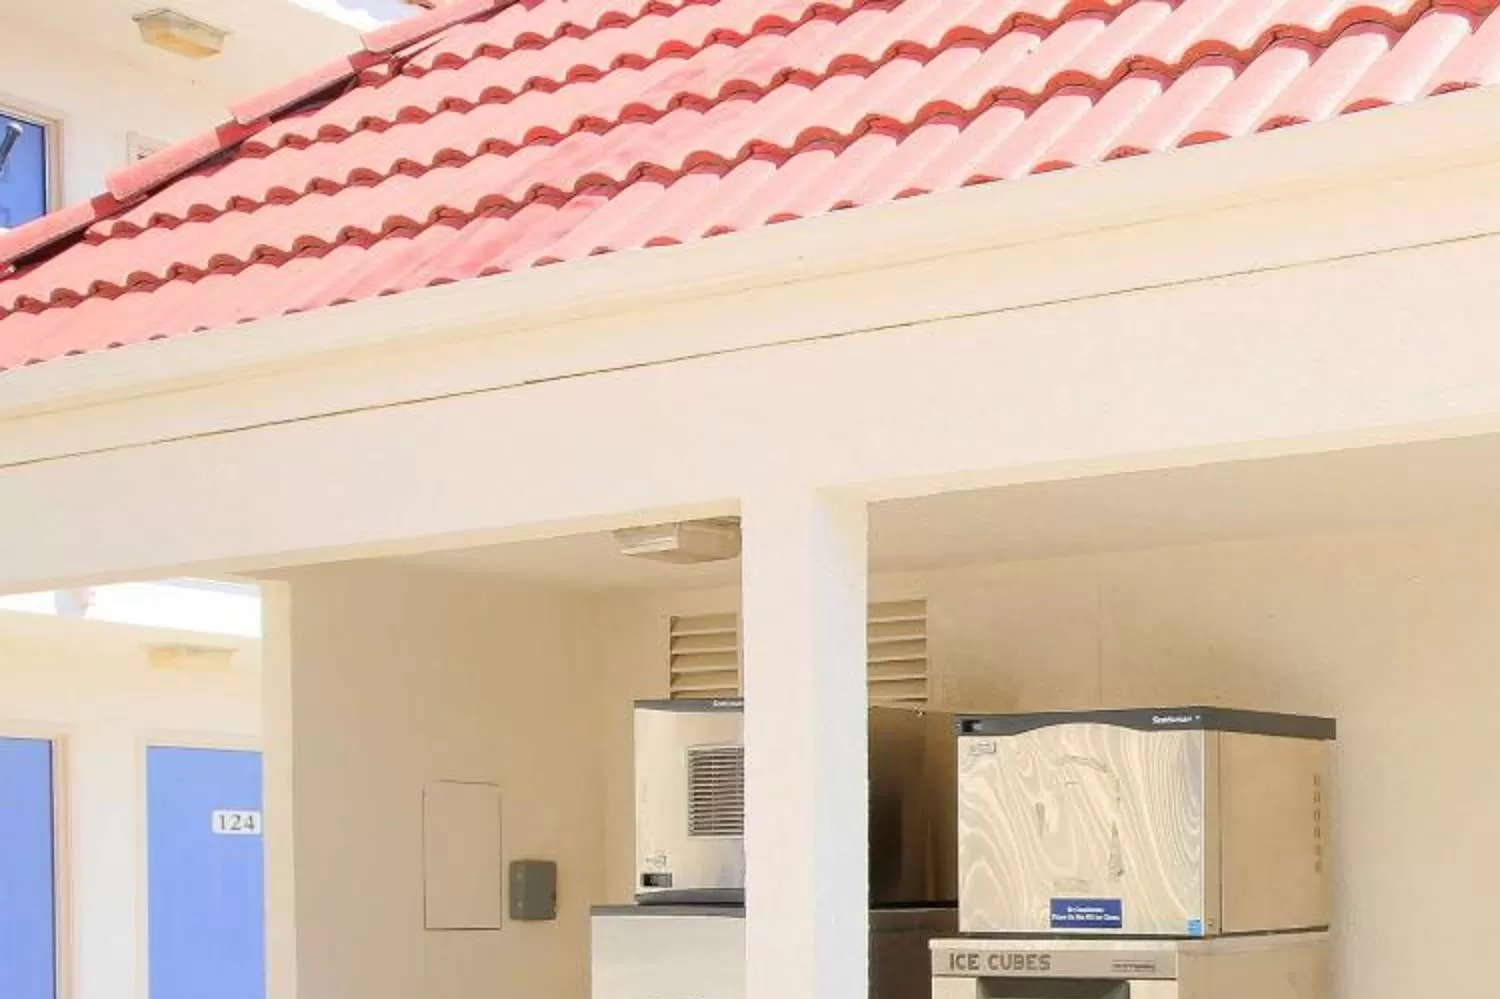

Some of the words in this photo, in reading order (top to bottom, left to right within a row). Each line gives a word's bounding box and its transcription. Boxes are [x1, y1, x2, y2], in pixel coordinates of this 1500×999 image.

[218, 813, 256, 831] 124
[949, 953, 980, 971] ICE
[987, 953, 1052, 972] CUBES
